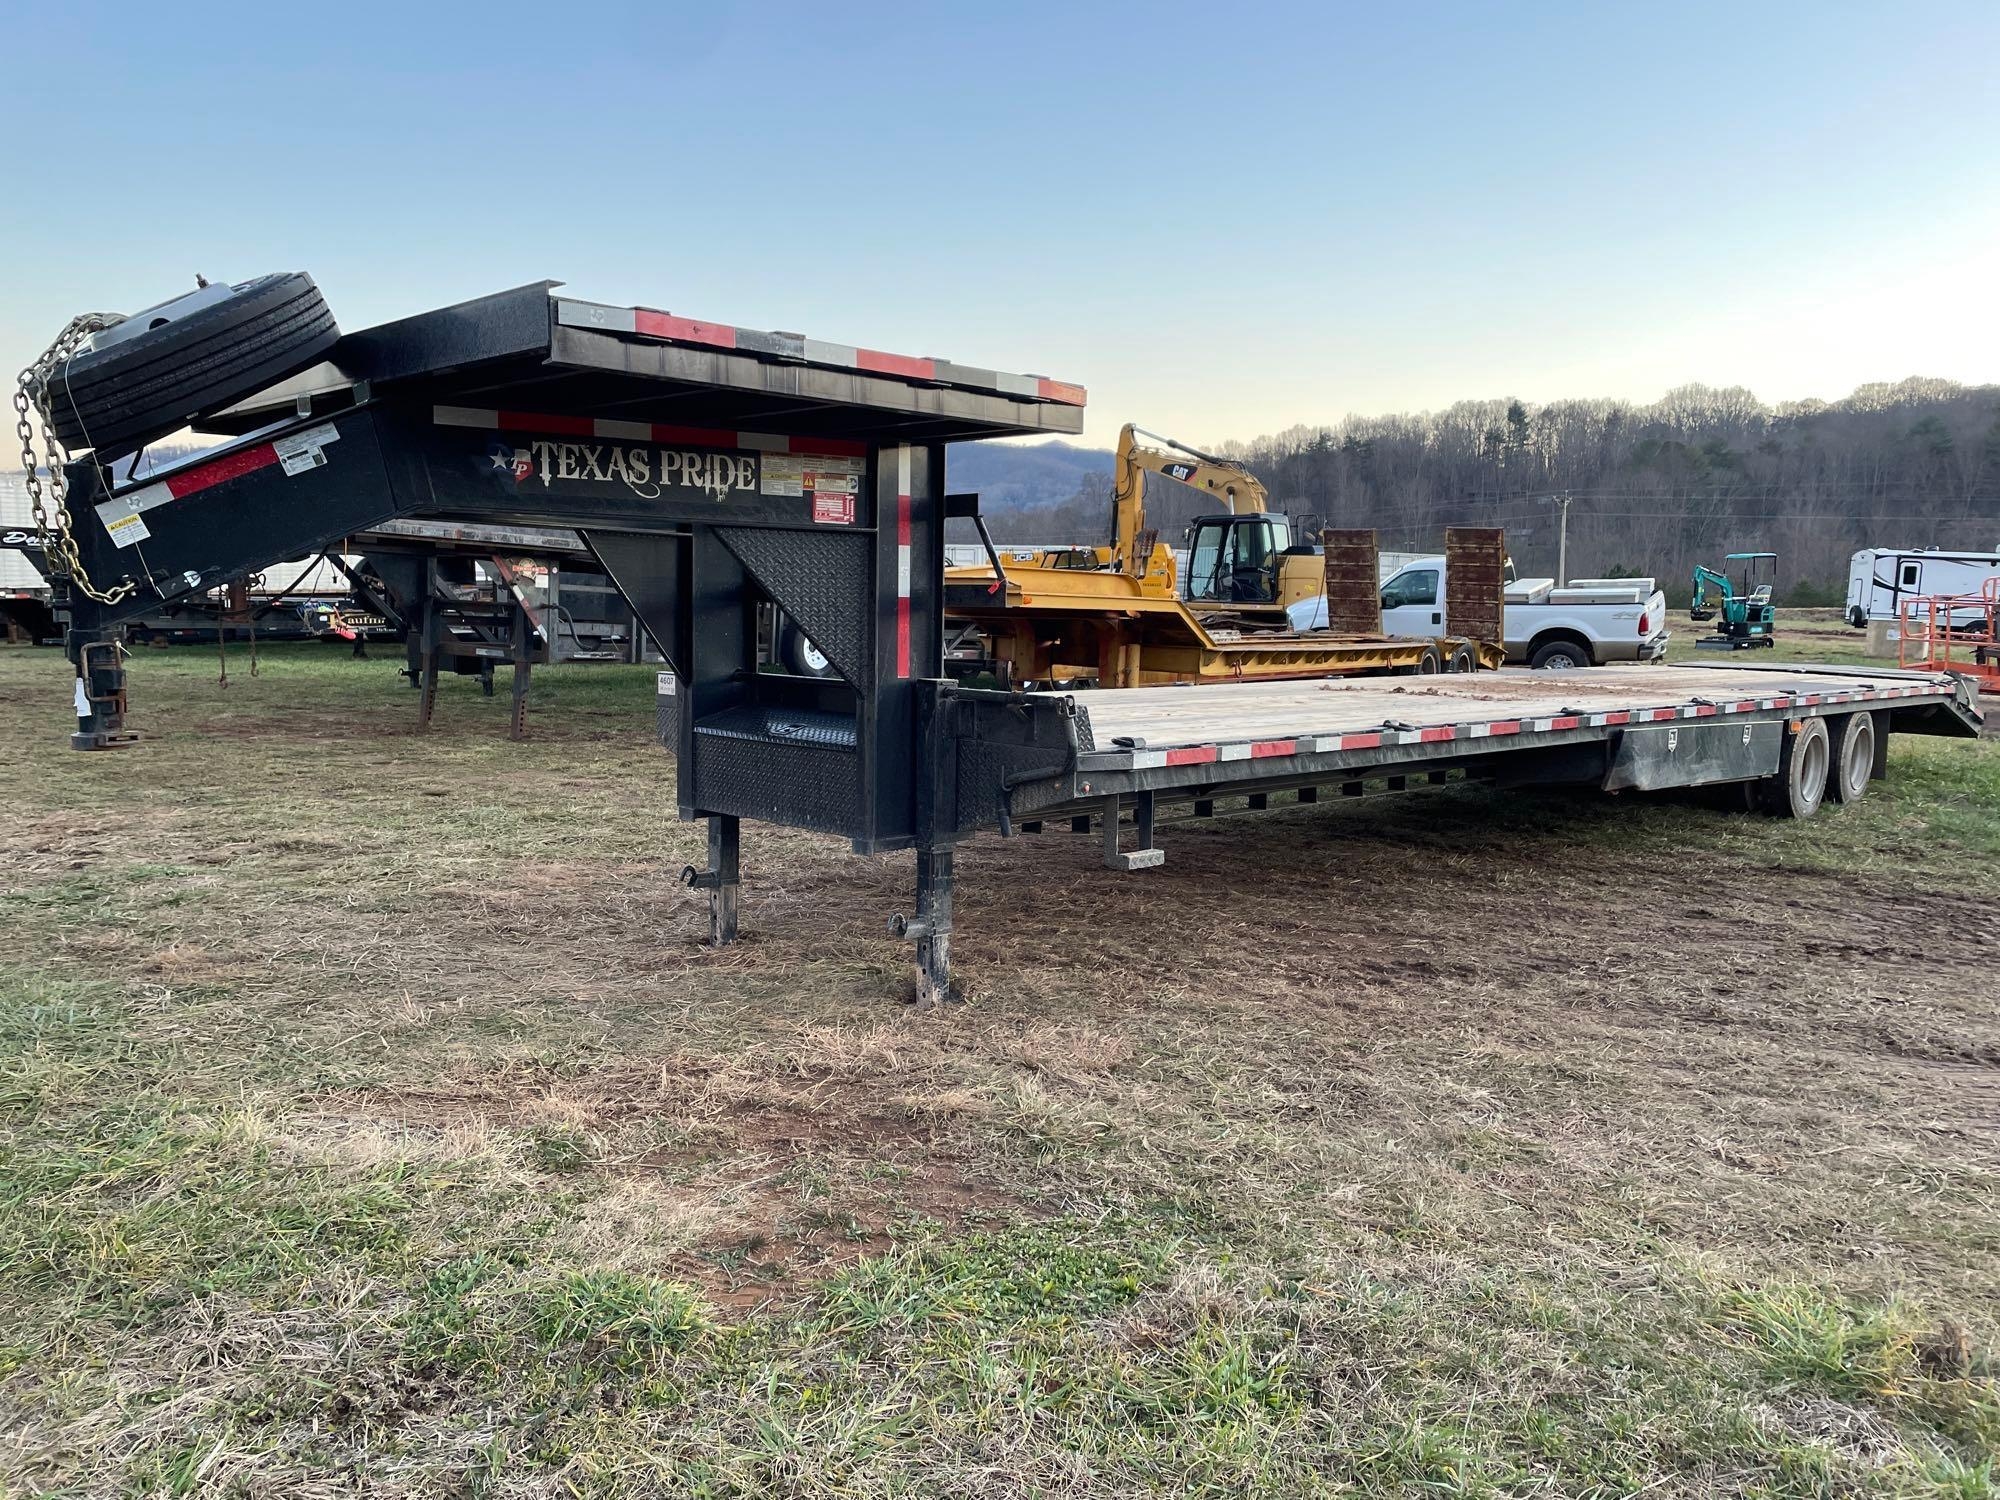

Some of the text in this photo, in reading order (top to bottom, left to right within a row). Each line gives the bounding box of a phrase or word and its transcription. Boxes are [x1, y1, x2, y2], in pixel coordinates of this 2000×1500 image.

[532, 441, 756, 502] TEXAS PRIDE
[1172, 464, 1189, 480] CAT
[1012, 553, 1034, 562] JCB
[660, 676, 674, 685] 4607
